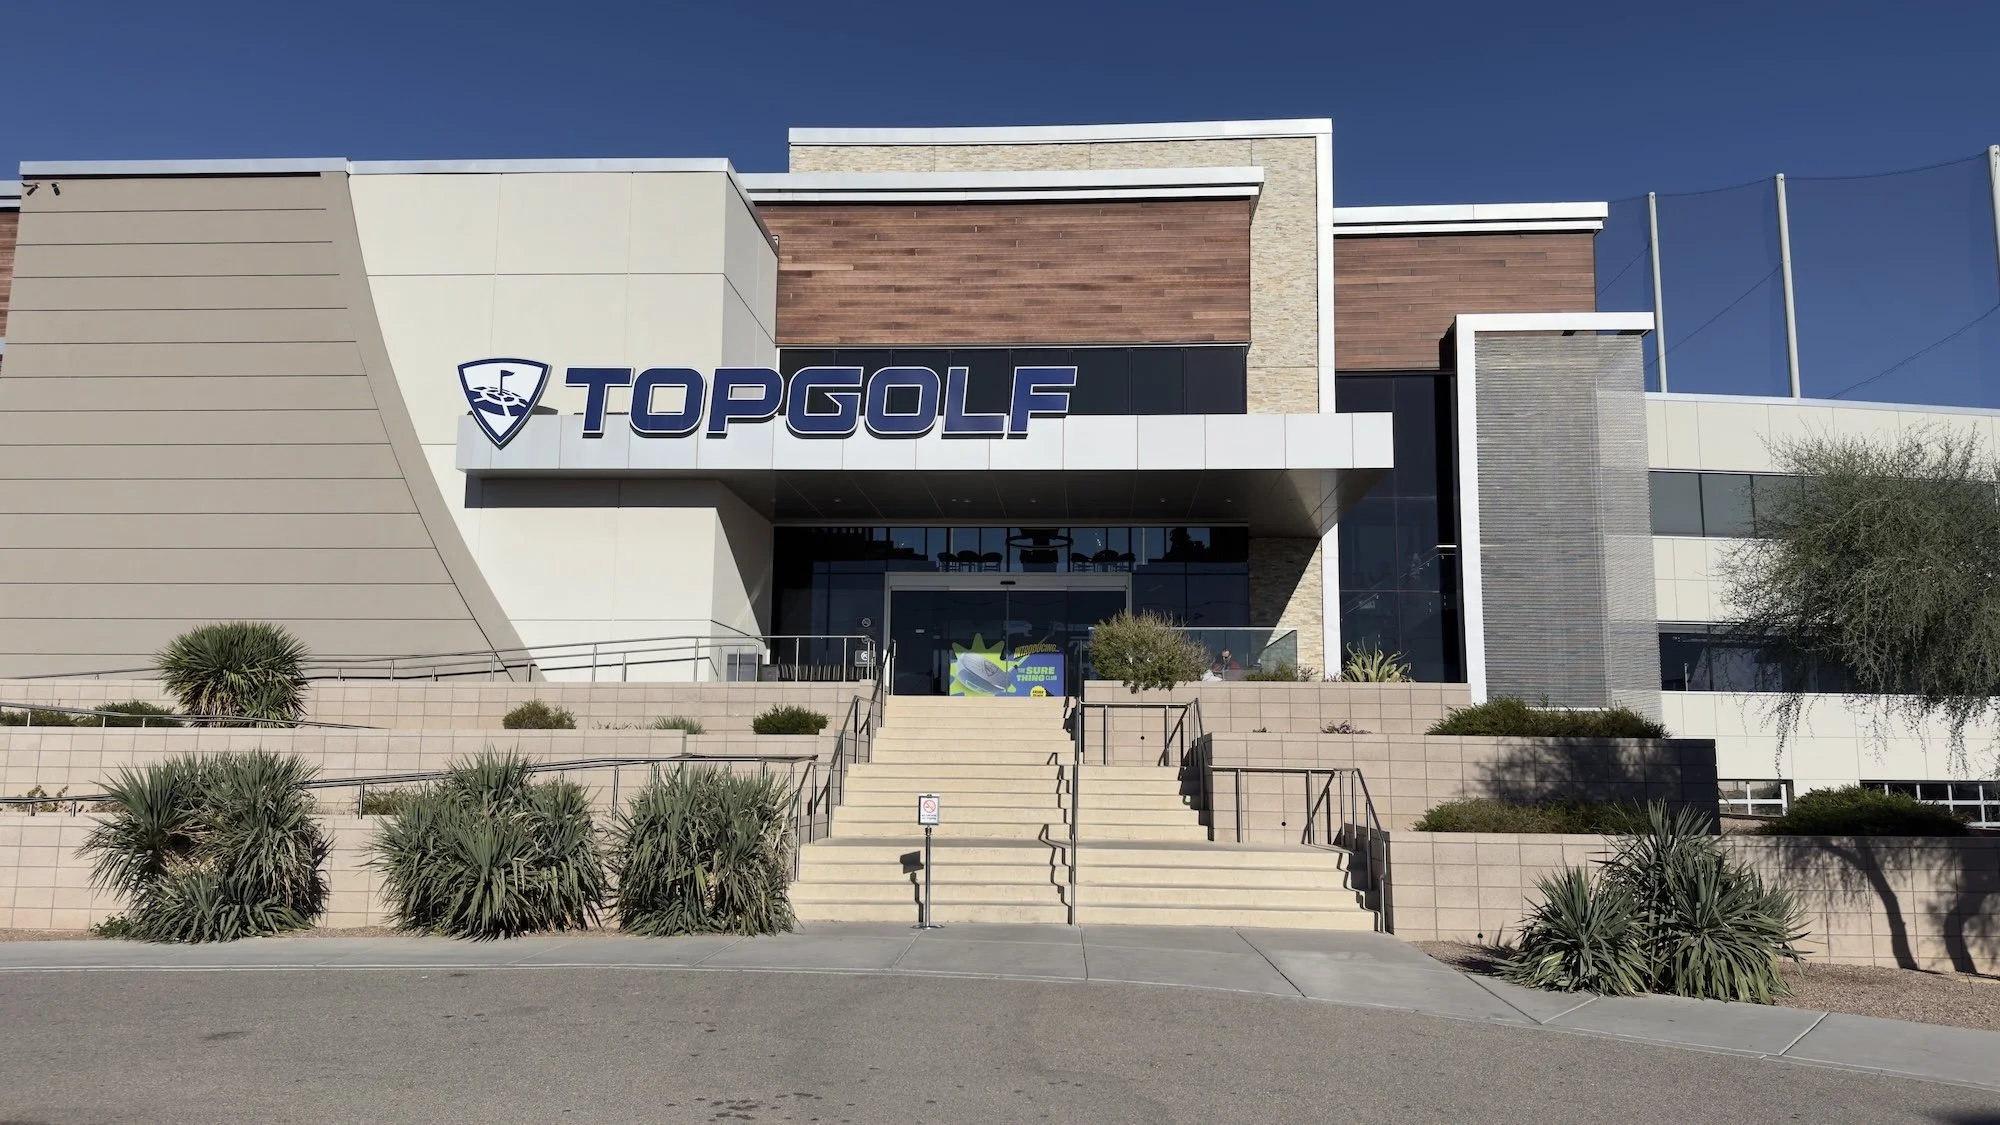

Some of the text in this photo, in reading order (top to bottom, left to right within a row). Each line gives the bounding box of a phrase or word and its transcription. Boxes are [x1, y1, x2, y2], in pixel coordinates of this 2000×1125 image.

[564, 365, 1078, 437] TOPGOLF
[1026, 666, 1055, 675] SURE
[1016, 674, 1045, 682] THING
